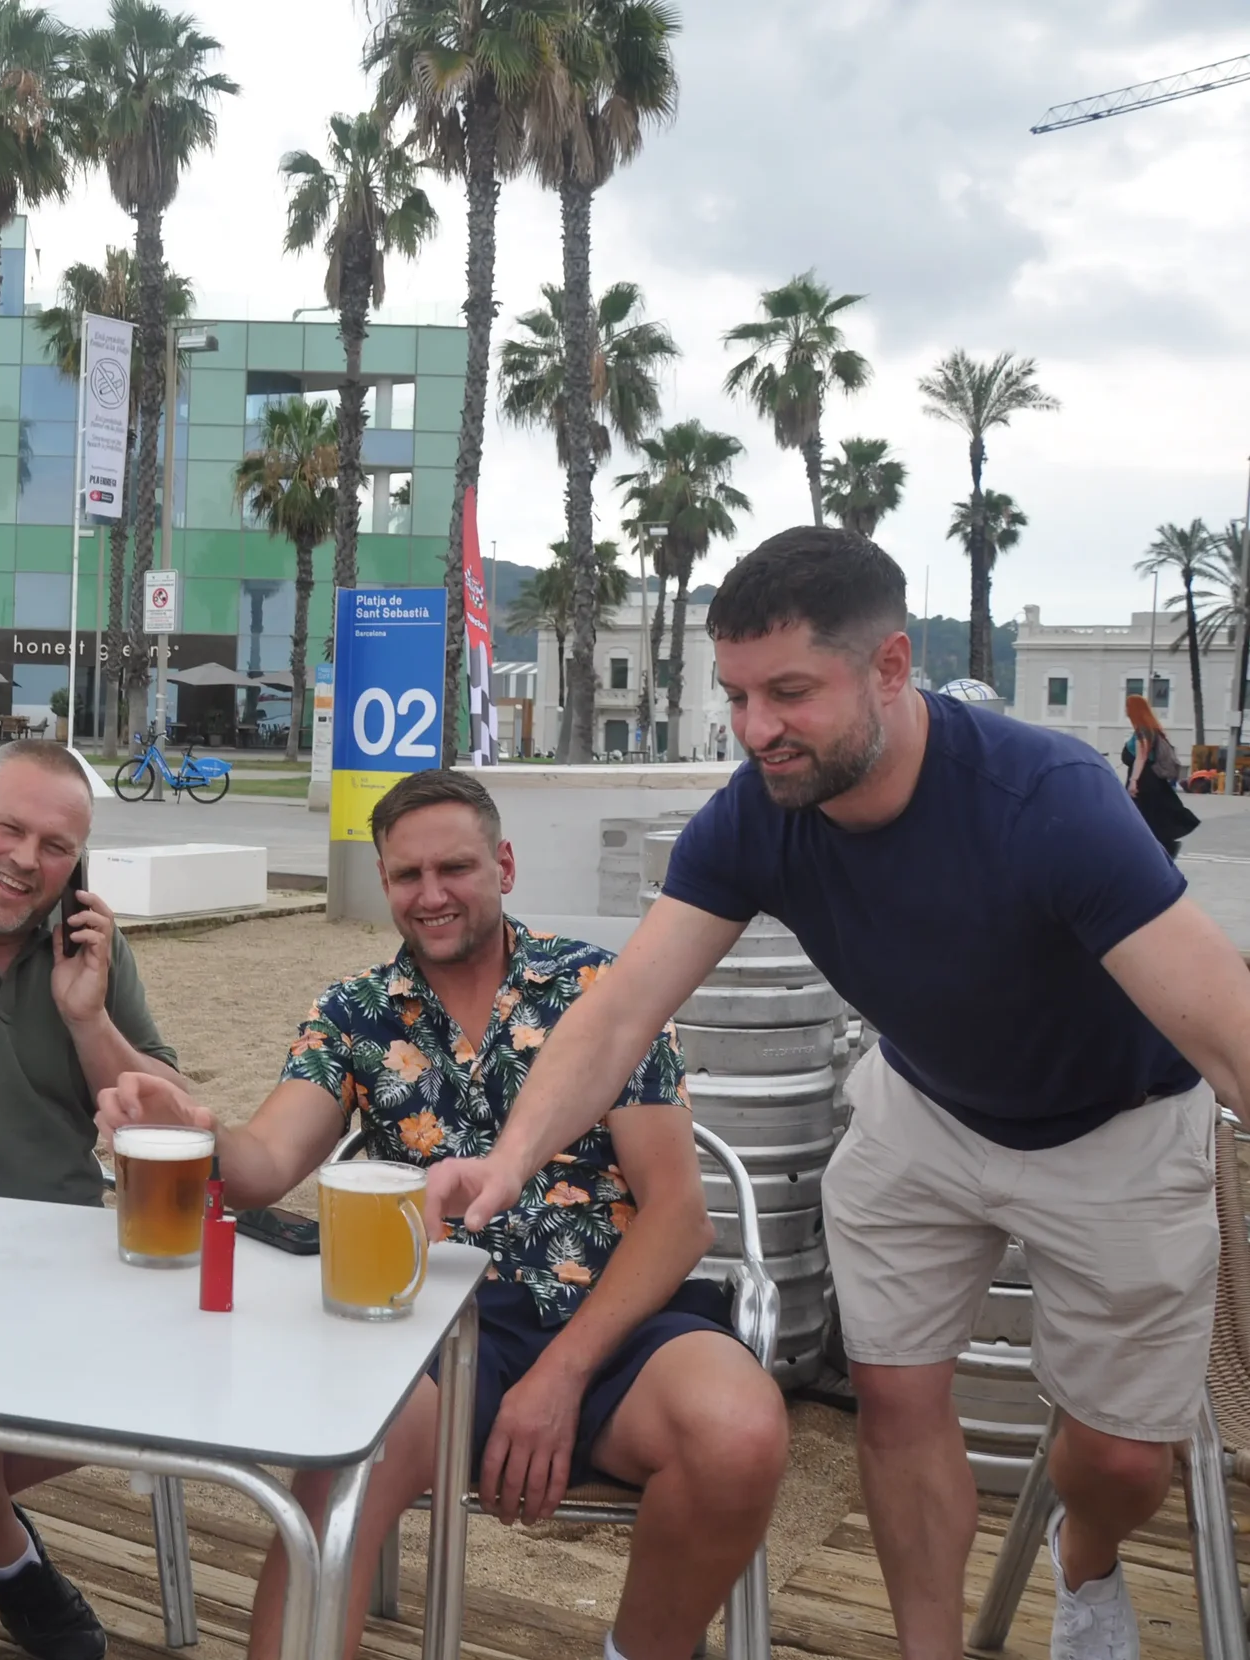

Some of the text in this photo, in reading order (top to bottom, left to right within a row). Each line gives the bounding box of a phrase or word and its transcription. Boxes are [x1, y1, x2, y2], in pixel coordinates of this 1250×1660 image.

[356, 594, 402, 607] Platja de
[355, 607, 430, 619] Sant Sebastià
[355, 629, 387, 637] Barcelona
[353, 687, 437, 757] 02
